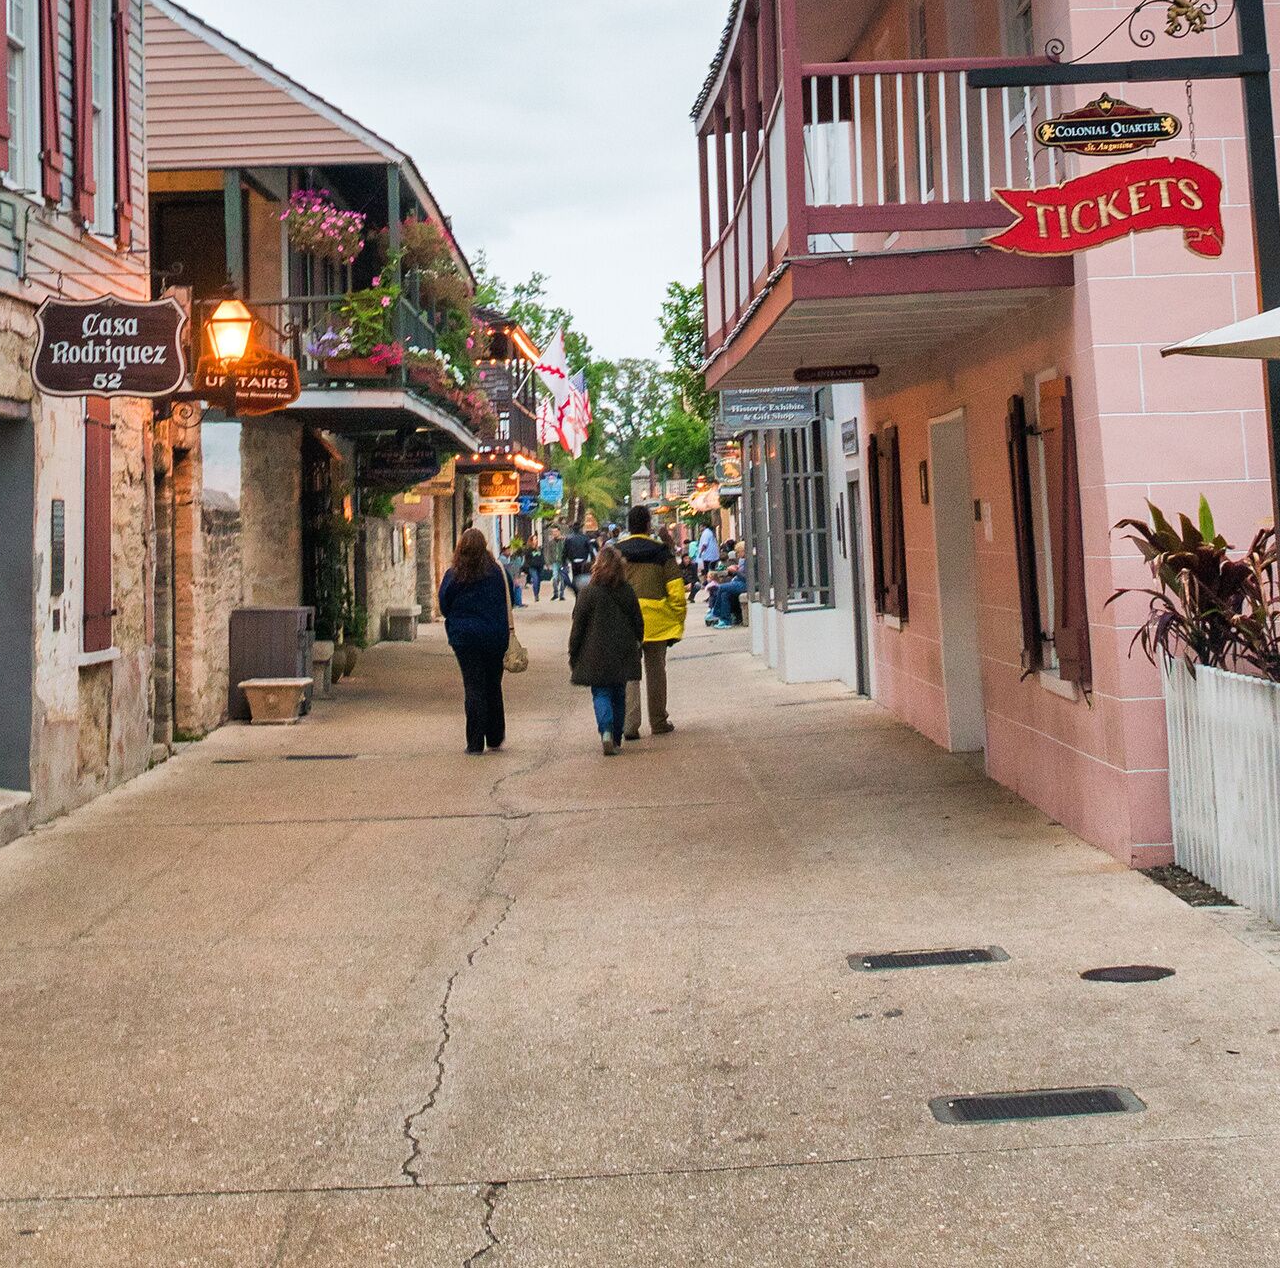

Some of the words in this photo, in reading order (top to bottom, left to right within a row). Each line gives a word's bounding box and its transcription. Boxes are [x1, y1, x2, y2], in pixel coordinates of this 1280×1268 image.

[1055, 125, 1109, 138] COLONIAL
[1110, 121, 1161, 138] QUARTER
[1096, 141, 1134, 152] Augustine
[1026, 177, 1205, 239] TICKETS
[81, 312, 139, 339] Casa
[92, 372, 123, 389] 52
[205, 375, 289, 390] UPTAIRS
[731, 403, 767, 412] Historic
[768, 402, 805, 412] Exhibits
[753, 412, 770, 421] Gift
[770, 412, 795, 421] Shop
